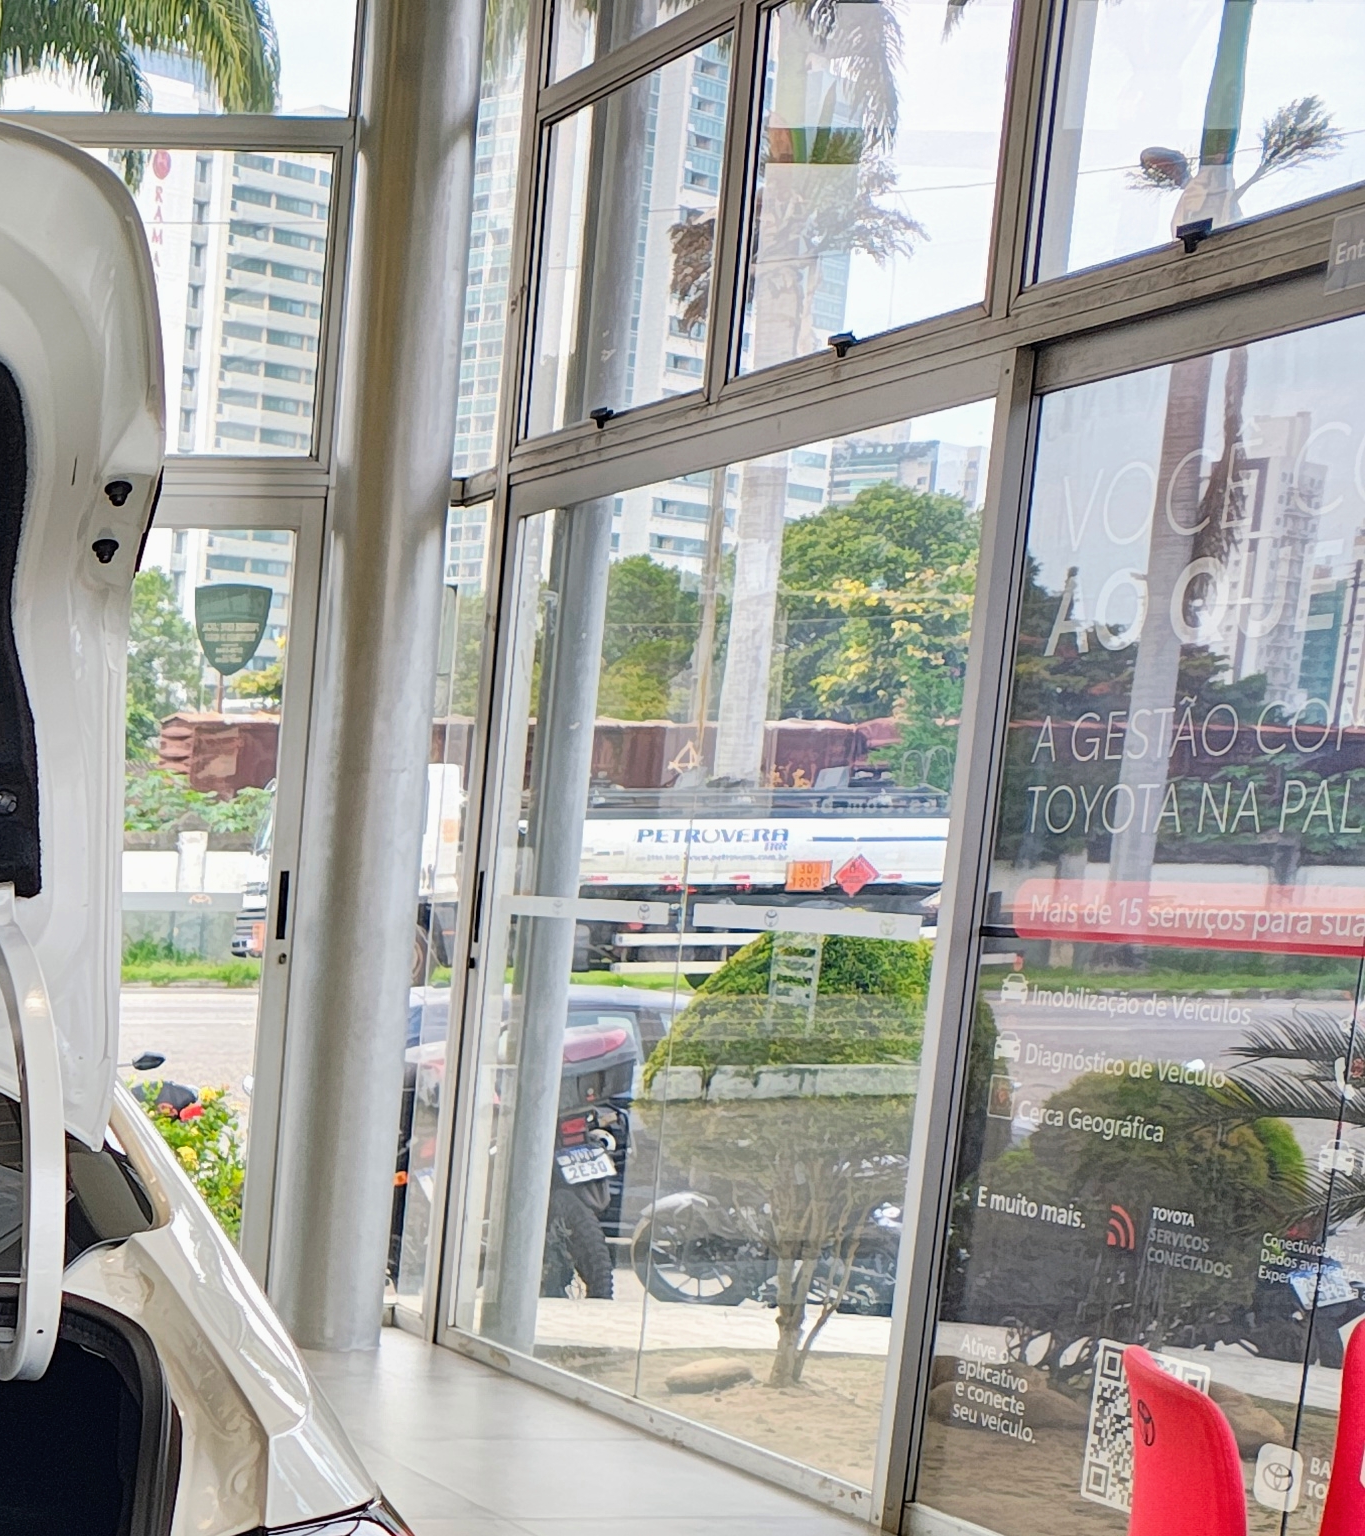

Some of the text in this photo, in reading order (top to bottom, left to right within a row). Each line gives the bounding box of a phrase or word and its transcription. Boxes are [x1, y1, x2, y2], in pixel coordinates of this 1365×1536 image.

[1064, 415, 1263, 552] VOCÊ
[1044, 539, 1345, 657] AO QUE
[1031, 715, 1056, 763] A
[1071, 695, 1239, 762] GESTÃO
[1028, 779, 1364, 834] TOYOTA NA PAL
[1030, 894, 1077, 925] Mais
[1083, 896, 1112, 925] de
[1118, 898, 1143, 926] 15
[1147, 903, 1246, 937] serviços
[1252, 911, 1312, 940] para
[1032, 984, 1252, 1025] Imobilização de Veículos
[1025, 1042, 1226, 1089] Diagnóstico de Veículo
[1018, 1100, 1165, 1142] Cerca Geográfica
[977, 1186, 1086, 1229] E muito mais.
[1152, 1206, 1195, 1227] TOYOTA
[1147, 1227, 1210, 1252] SERVIÇOS
[1263, 1232, 1345, 1261] Conectividade
[1146, 1246, 1233, 1279] CONECTADOS
[1260, 1248, 1362, 1280] Dados avançados
[959, 1334, 1009, 1363] Ative o
[957, 1360, 1029, 1394] aplicativo
[955, 1381, 1026, 1416] e conecte
[952, 1403, 1037, 1444] seu veículo.
